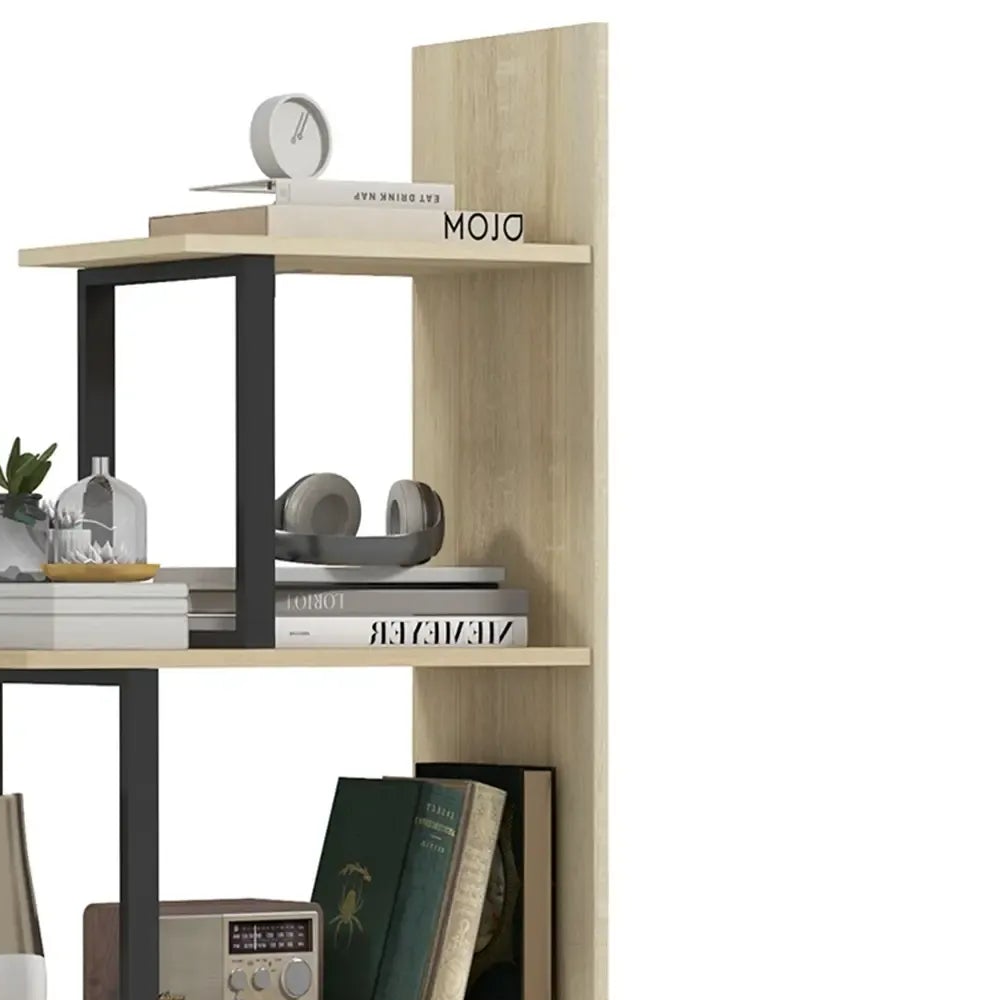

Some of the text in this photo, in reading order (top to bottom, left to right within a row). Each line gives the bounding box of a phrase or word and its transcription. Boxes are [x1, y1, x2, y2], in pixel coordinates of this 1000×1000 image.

[353, 191, 441, 204] EAT DRINK NAP
